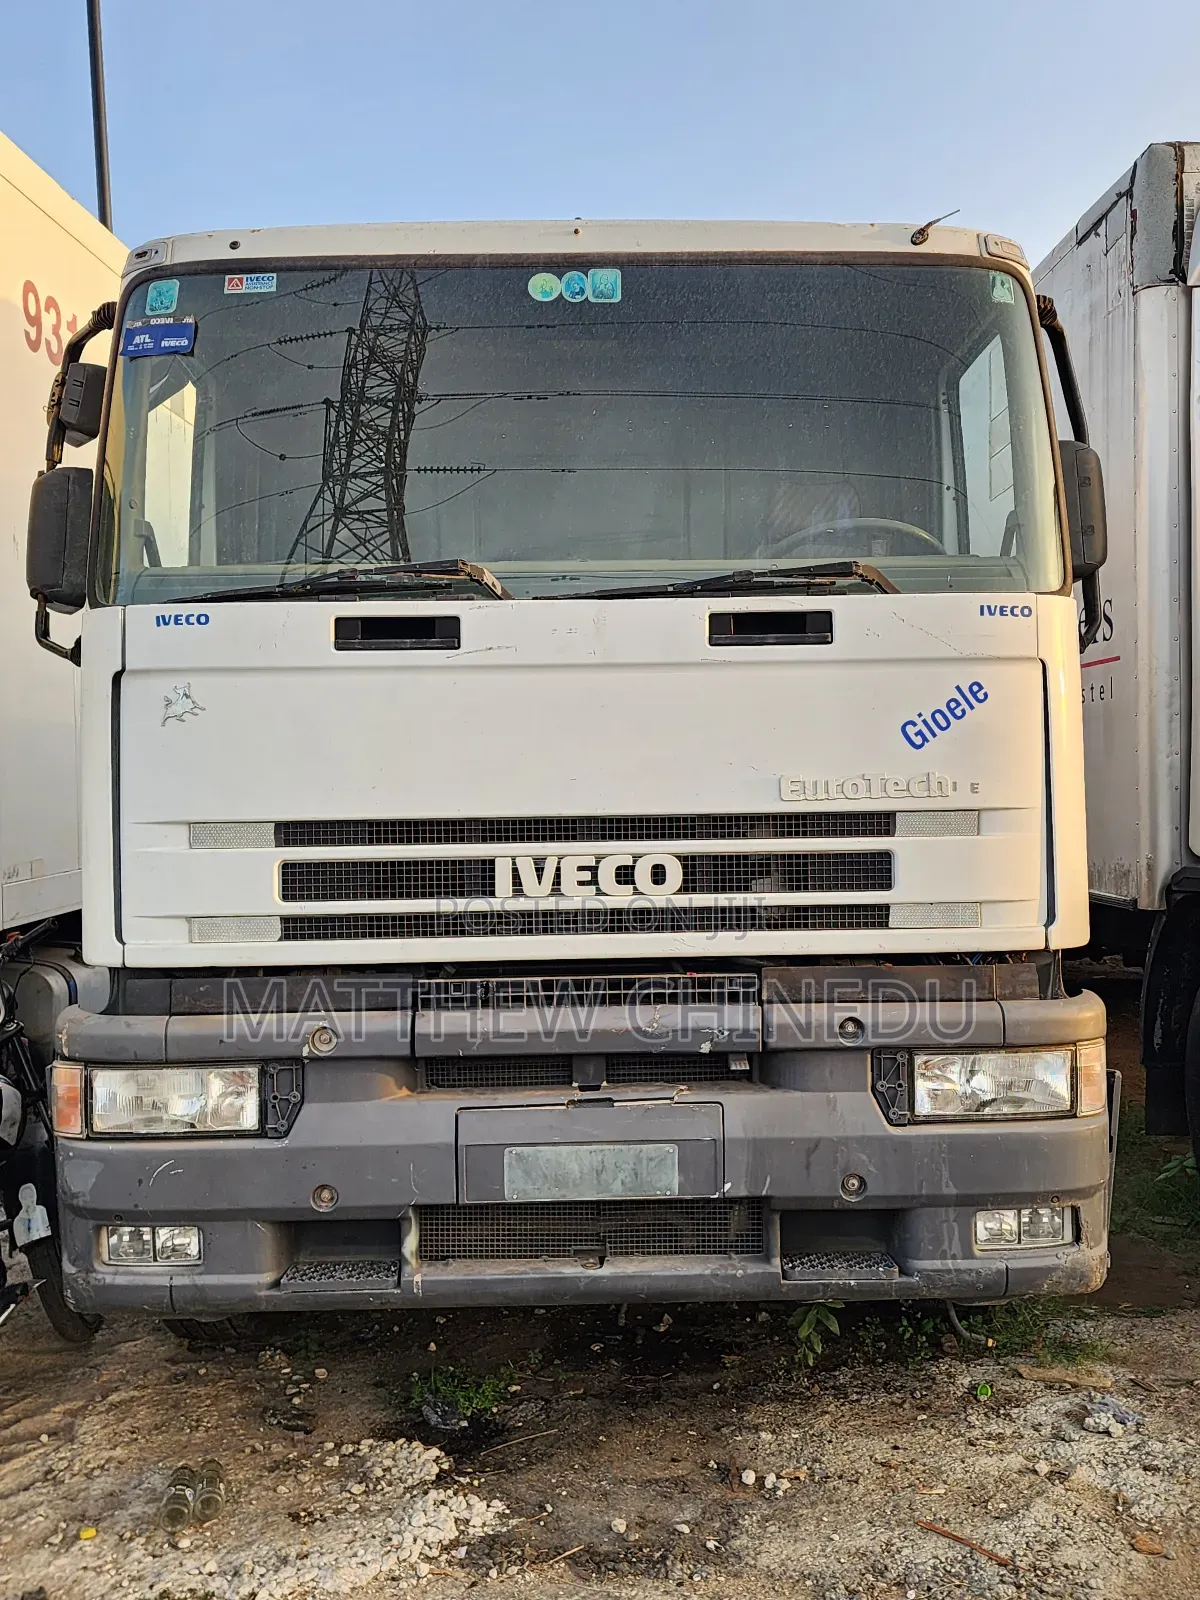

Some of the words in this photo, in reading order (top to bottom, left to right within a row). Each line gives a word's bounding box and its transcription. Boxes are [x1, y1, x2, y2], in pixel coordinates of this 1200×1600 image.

[133, 334, 150, 344] ATL
[161, 339, 188, 347] IVECO
[979, 604, 1032, 617] IVECO
[155, 613, 210, 627] IVECO
[900, 681, 989, 750] Gioele
[780, 771, 950, 801] EuroTech
[495, 854, 683, 897] IVECO
